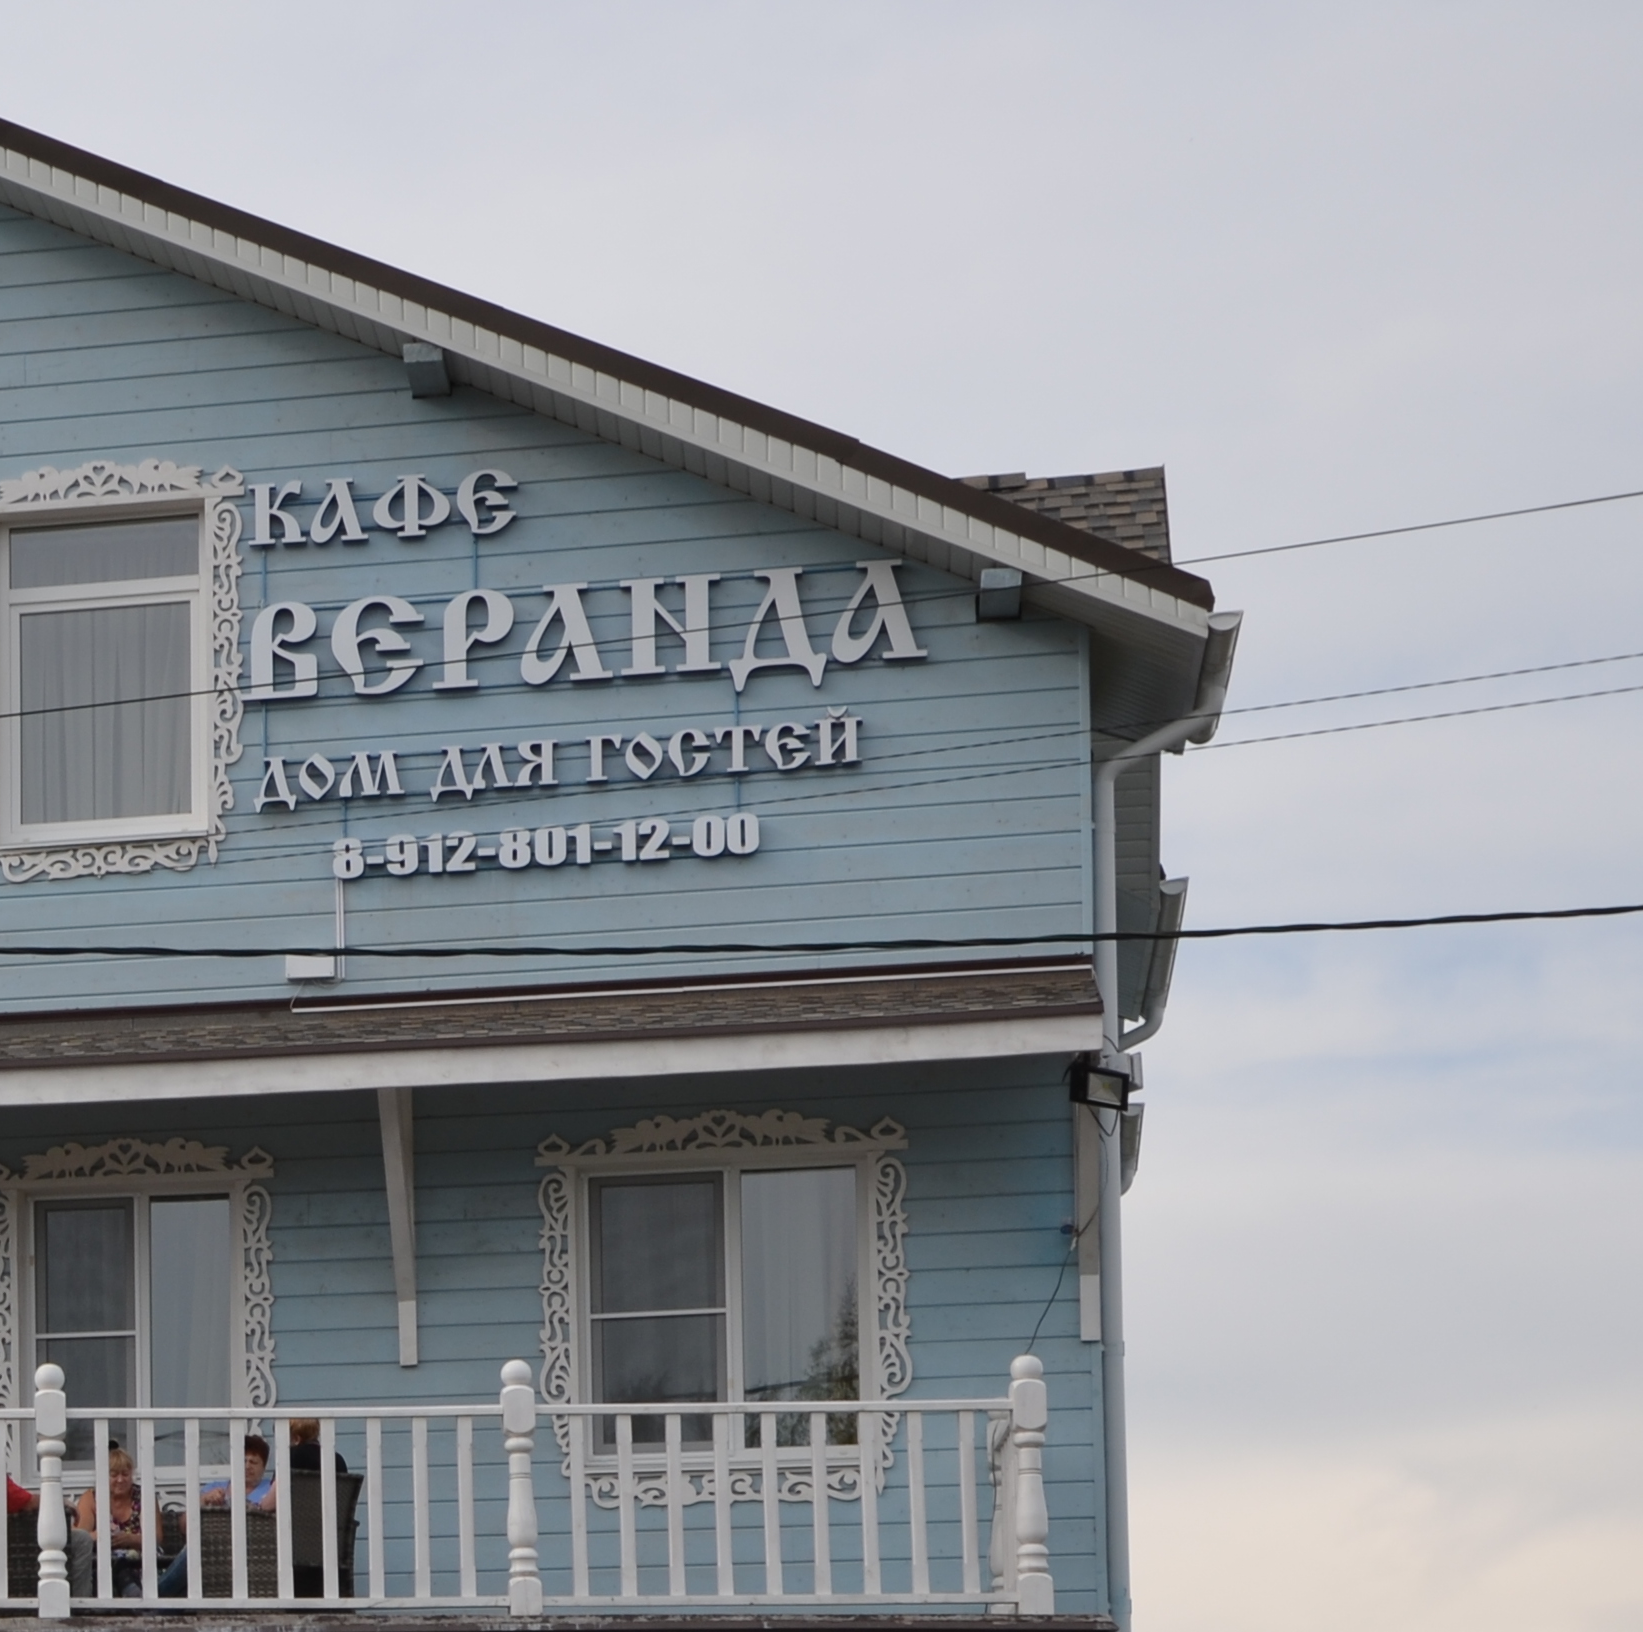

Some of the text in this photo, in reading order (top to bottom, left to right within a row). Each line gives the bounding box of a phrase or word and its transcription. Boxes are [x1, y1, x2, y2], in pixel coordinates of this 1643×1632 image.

[248, 469, 518, 547] КАФЕ
[241, 559, 927, 701] ВЕРАНДА
[254, 706, 863, 812] ДОМ ДЛЯ ГОСТЕЙ
[332, 813, 761, 879] 8-912-801-12-00
